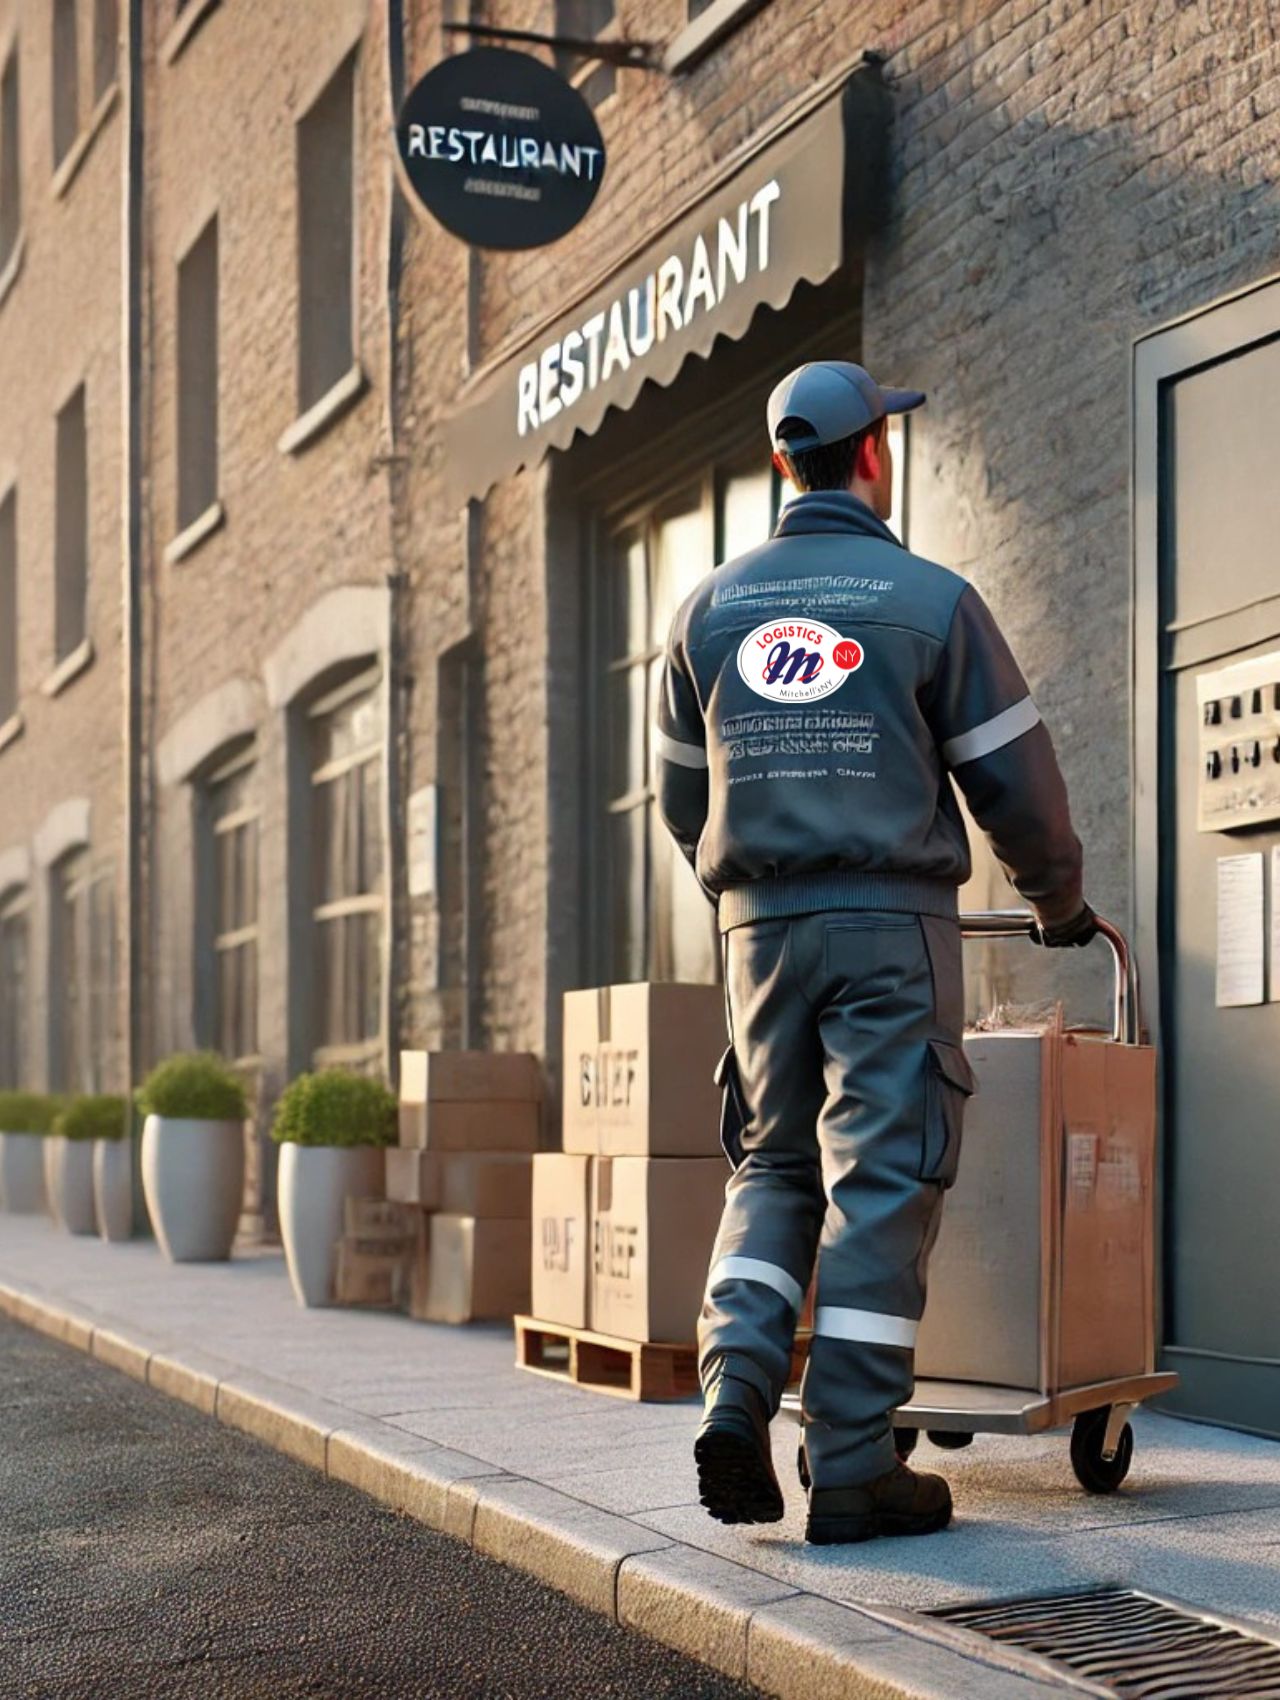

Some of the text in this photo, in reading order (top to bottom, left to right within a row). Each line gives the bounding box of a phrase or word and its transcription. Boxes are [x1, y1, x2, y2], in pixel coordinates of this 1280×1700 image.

[408, 123, 601, 181] RESTAURANT
[517, 179, 780, 436] RESTAURANT
[756, 625, 823, 650] LOGISTICS
[835, 649, 858, 663] NY
